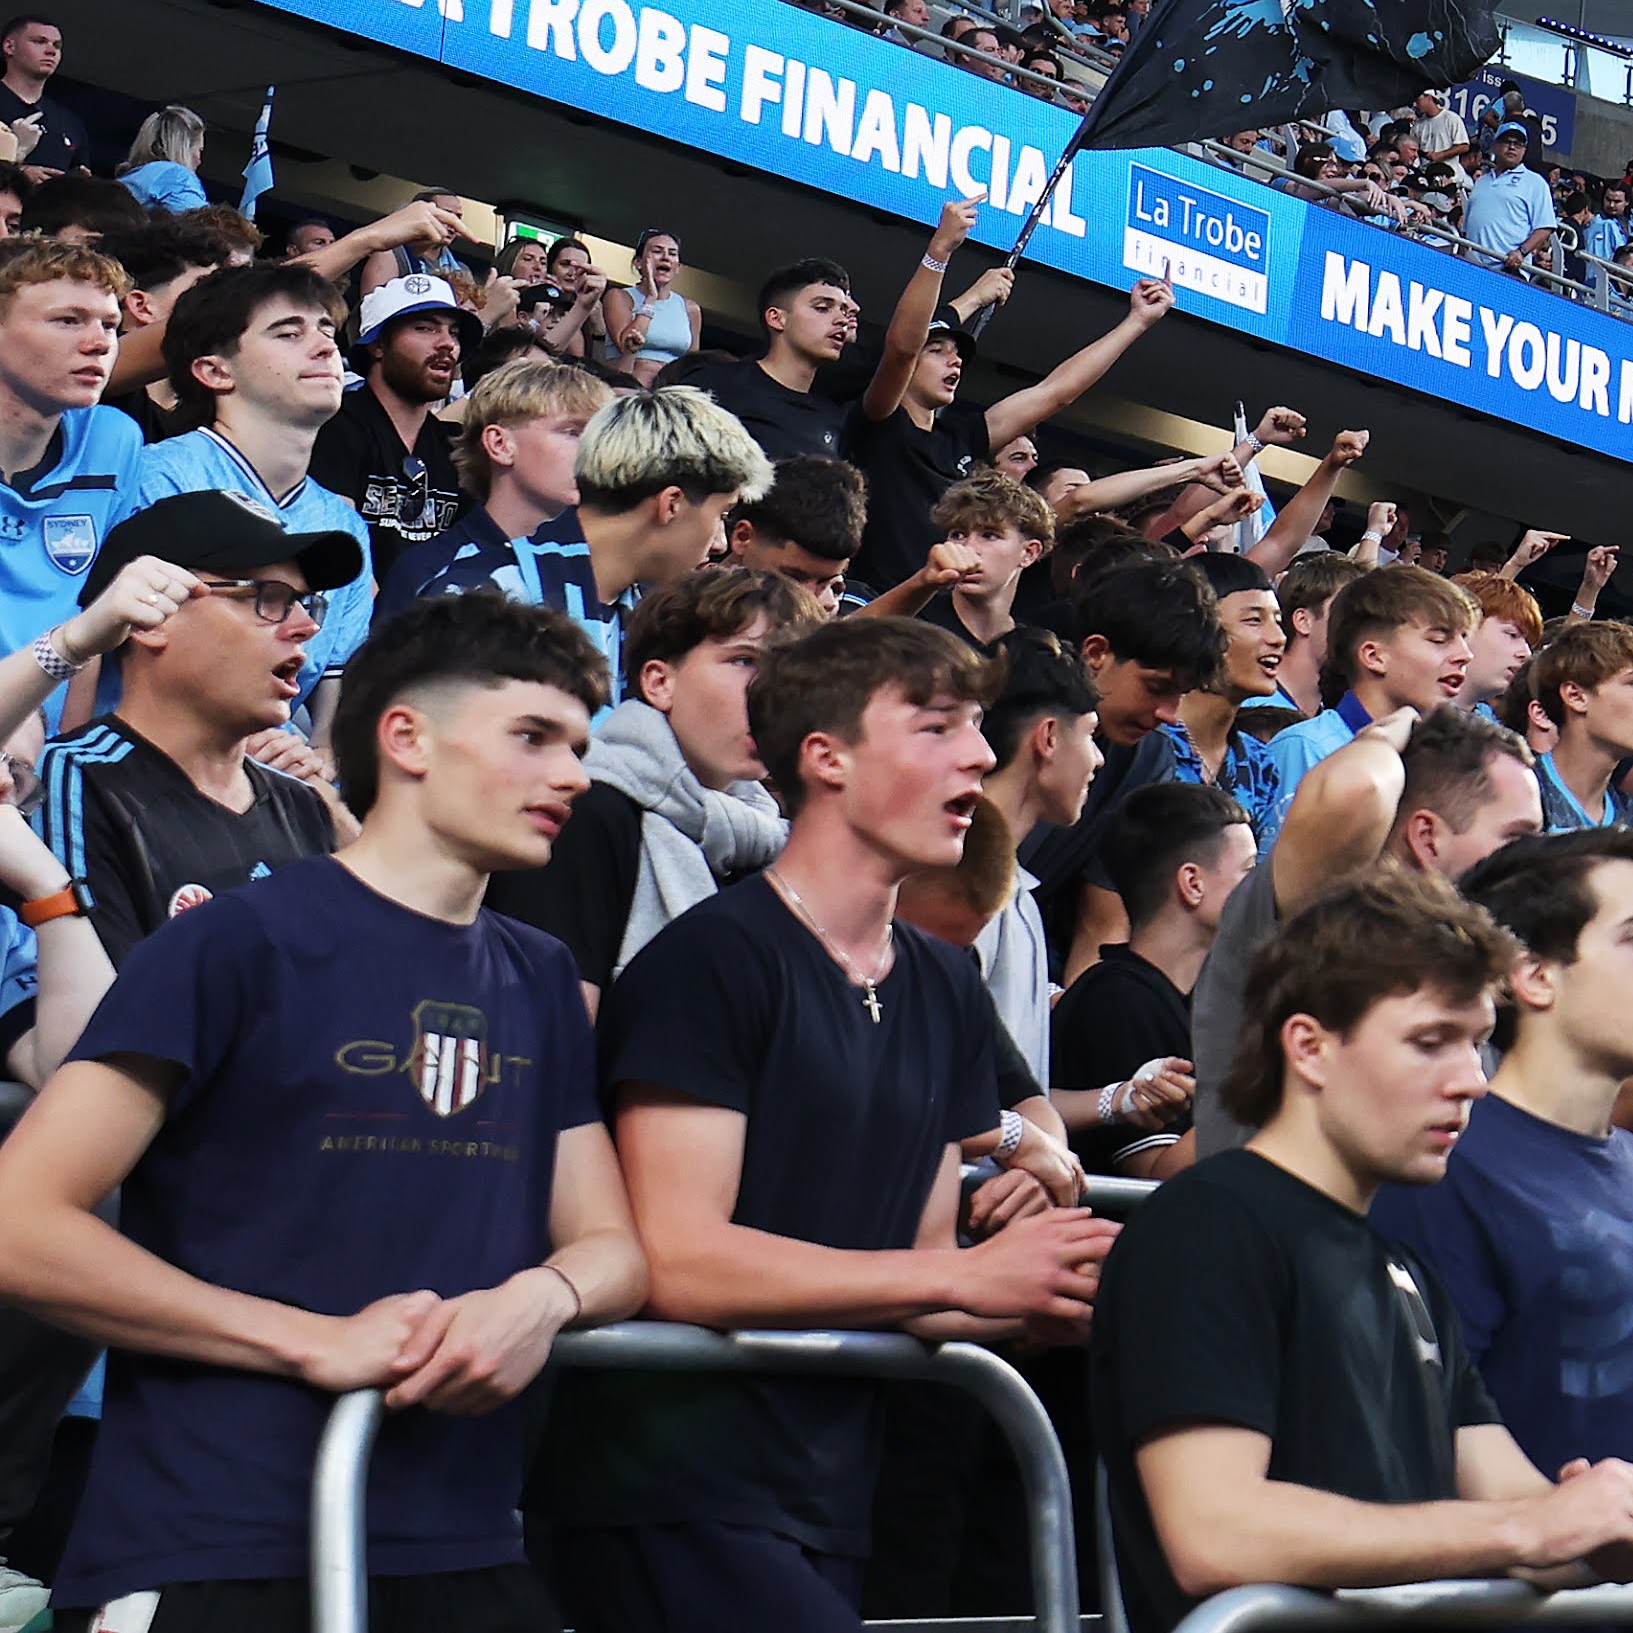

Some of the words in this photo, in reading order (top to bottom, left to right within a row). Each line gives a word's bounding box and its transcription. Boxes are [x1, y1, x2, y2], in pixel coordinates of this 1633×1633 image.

[740, 44, 1087, 238] FINANCIAL
[1135, 240, 1259, 302] financial
[1136, 180, 1170, 228] La
[1178, 195, 1261, 260] Trobe
[1320, 250, 1473, 368] MAKE
[1479, 305, 1611, 417] YOUR
